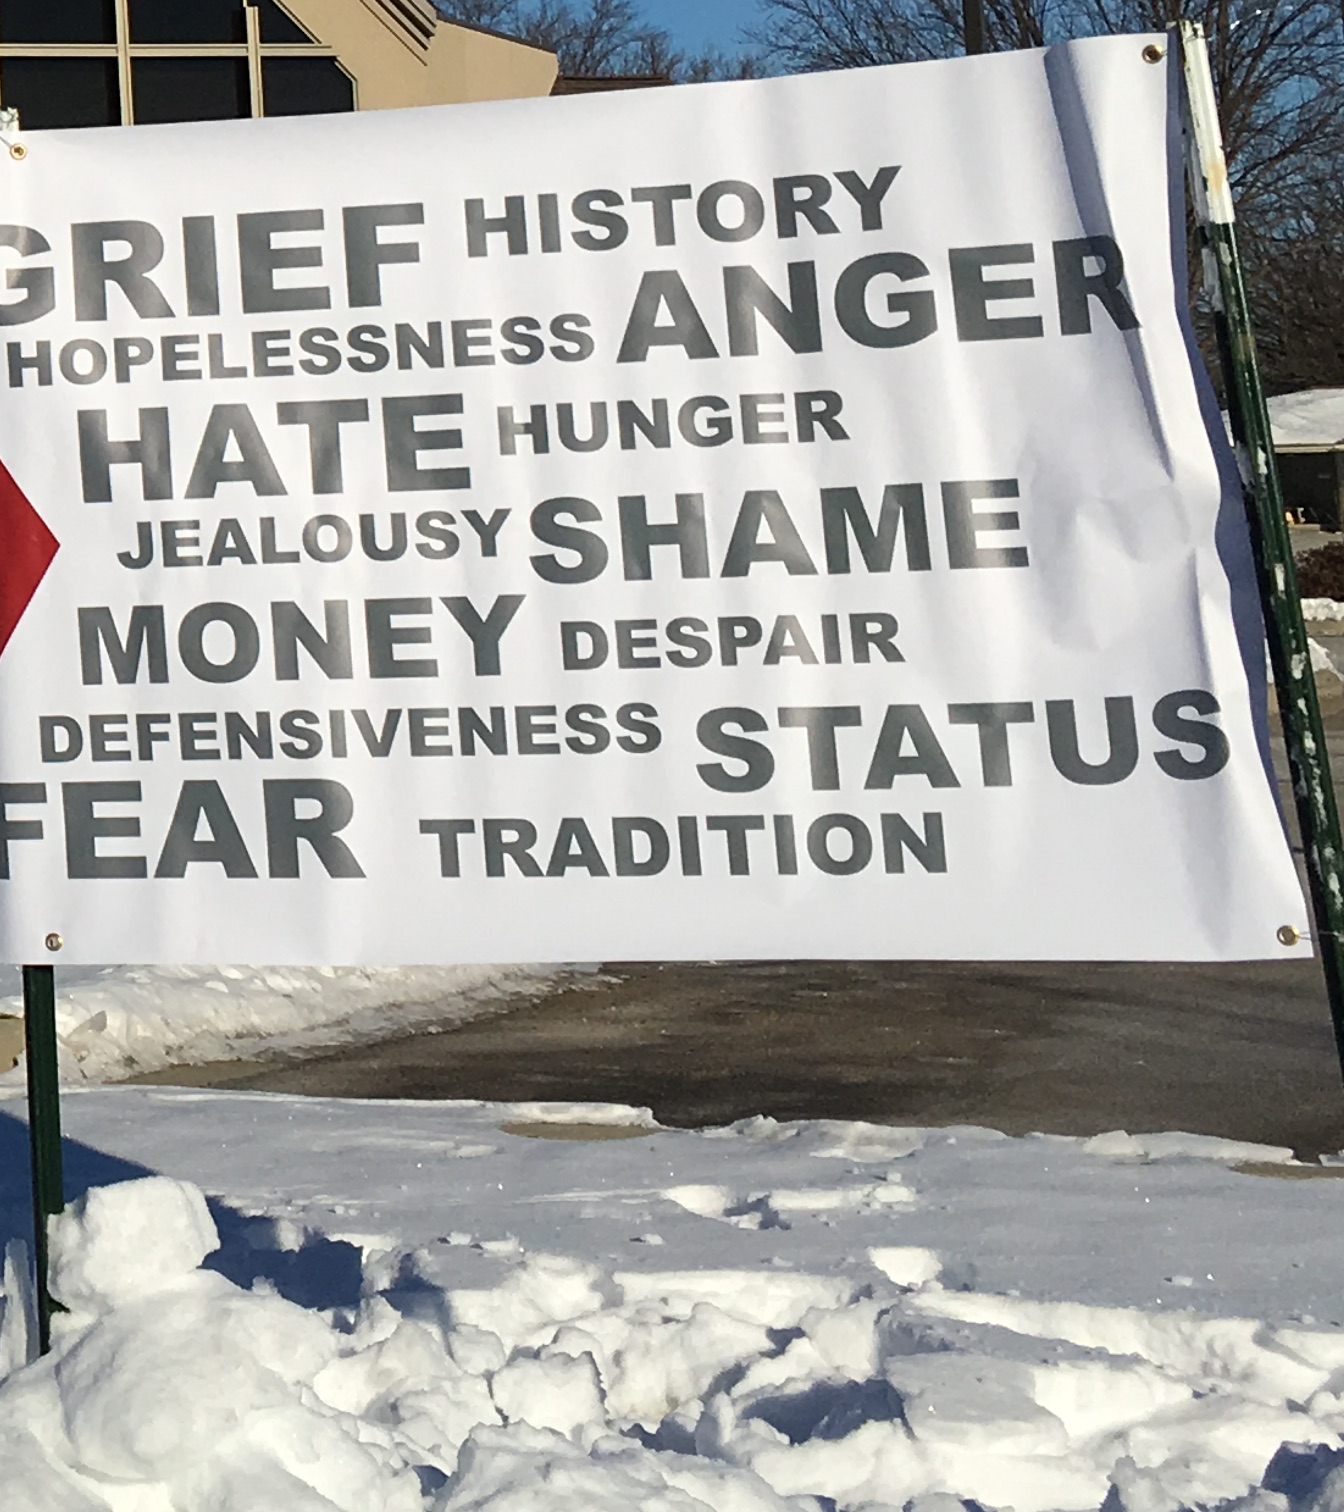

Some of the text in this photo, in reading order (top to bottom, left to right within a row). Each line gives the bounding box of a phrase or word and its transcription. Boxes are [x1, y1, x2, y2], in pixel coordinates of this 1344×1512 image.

[463, 165, 904, 258] HISTORY
[6, 234, 1144, 388] HOPELESSNESS ANGER
[77, 390, 851, 504] HATE HUNGER
[116, 477, 1031, 586] JEALOUSY SHAME
[77, 594, 907, 686] MONEY DESPAIR
[38, 688, 1231, 793] DEFENSIVENESS STATUS
[418, 812, 948, 878] TRADITION
